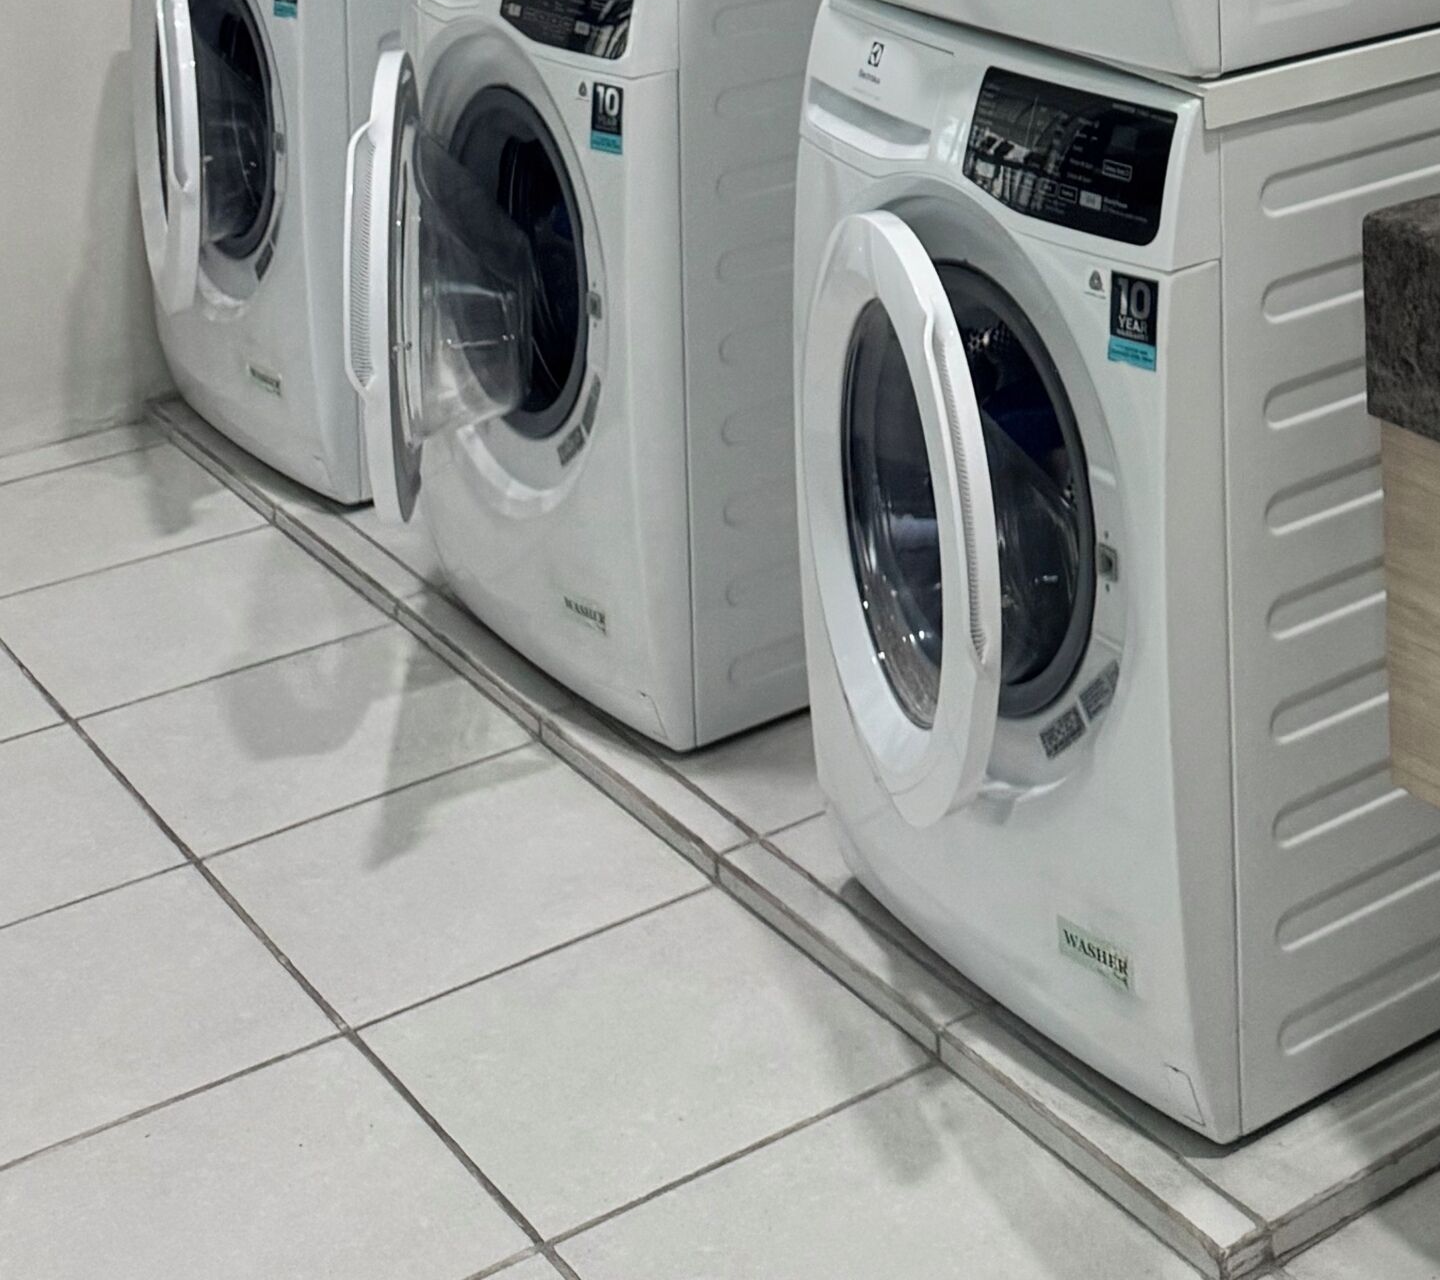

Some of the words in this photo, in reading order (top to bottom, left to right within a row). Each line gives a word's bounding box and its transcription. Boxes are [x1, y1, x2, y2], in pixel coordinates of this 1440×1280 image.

[596, 85, 620, 116] 10
[1117, 277, 1152, 320] 10
[1118, 314, 1149, 336] YEAR
[1063, 928, 1128, 978] WASHER
